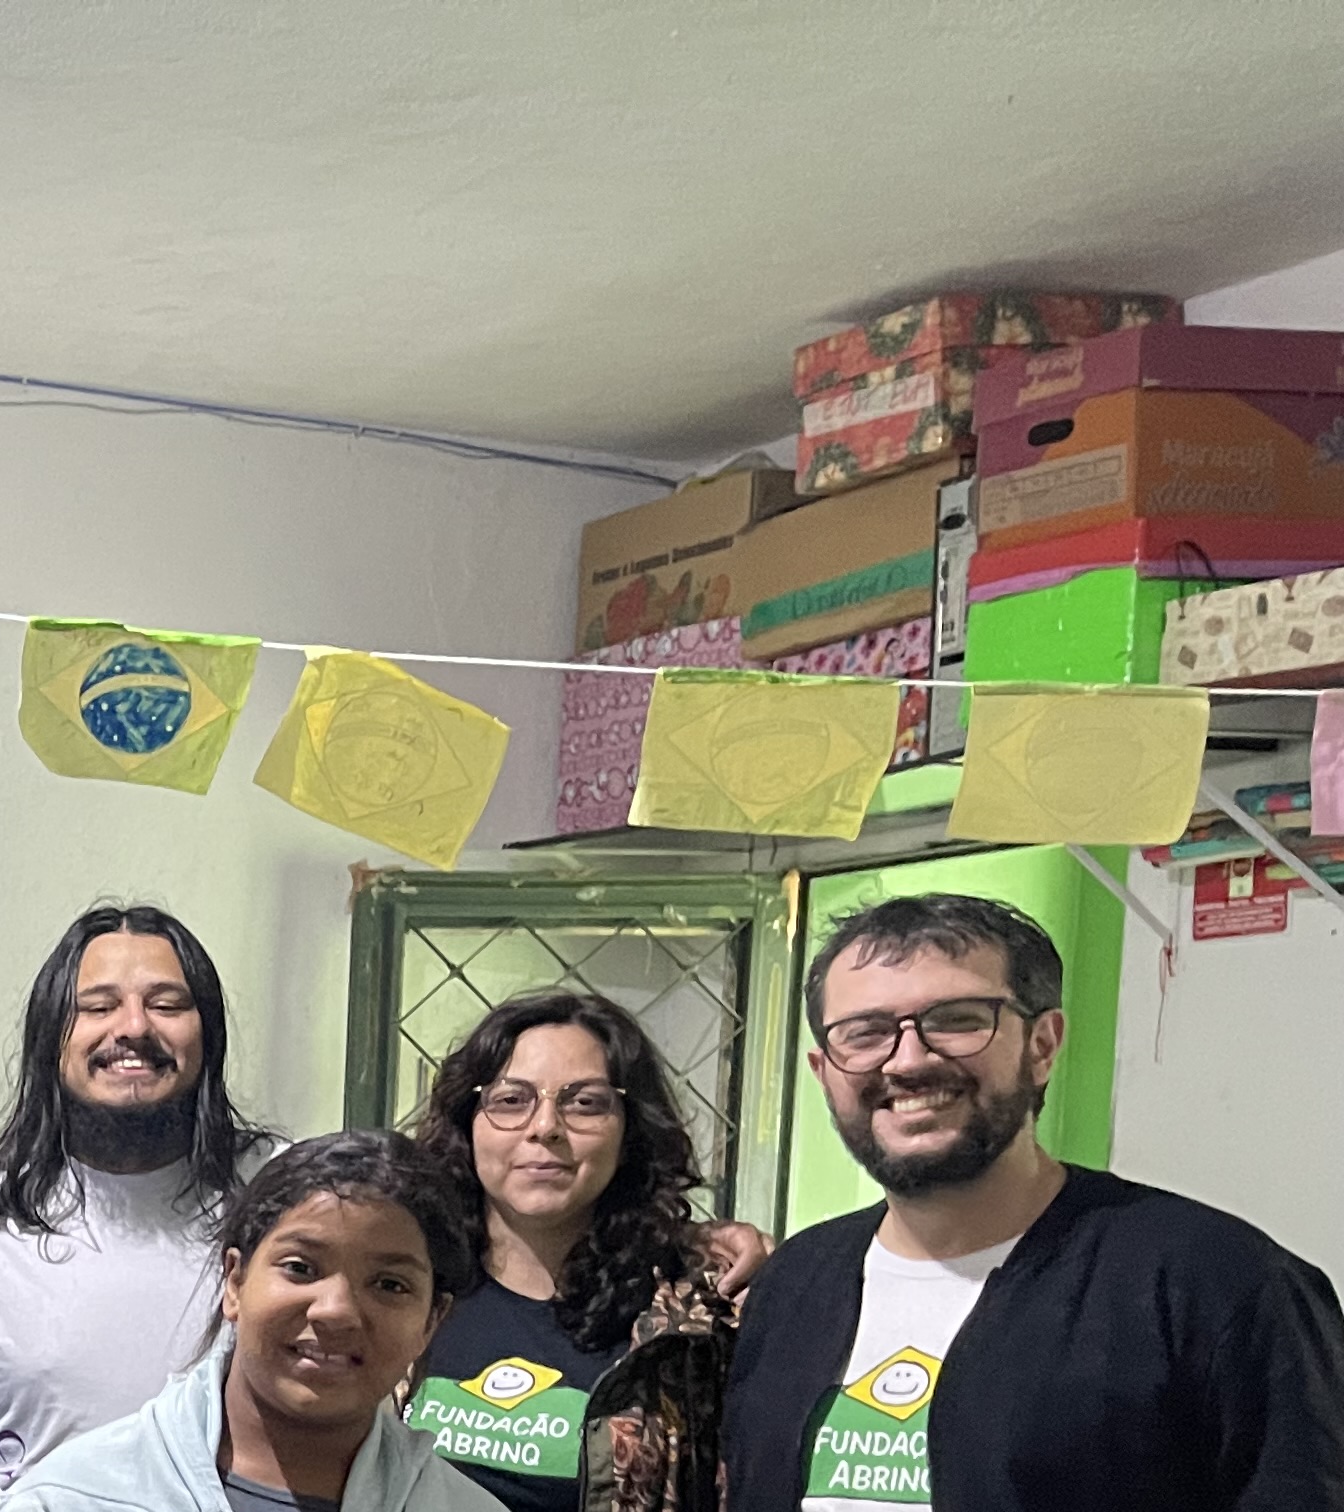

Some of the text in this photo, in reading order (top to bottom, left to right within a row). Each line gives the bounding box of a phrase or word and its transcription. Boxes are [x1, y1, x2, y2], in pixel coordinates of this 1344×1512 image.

[420, 1400, 570, 1438] FUNDAÇÃO
[432, 1426, 540, 1466] ABRINQ
[813, 1425, 928, 1460] FUNDAÇ
